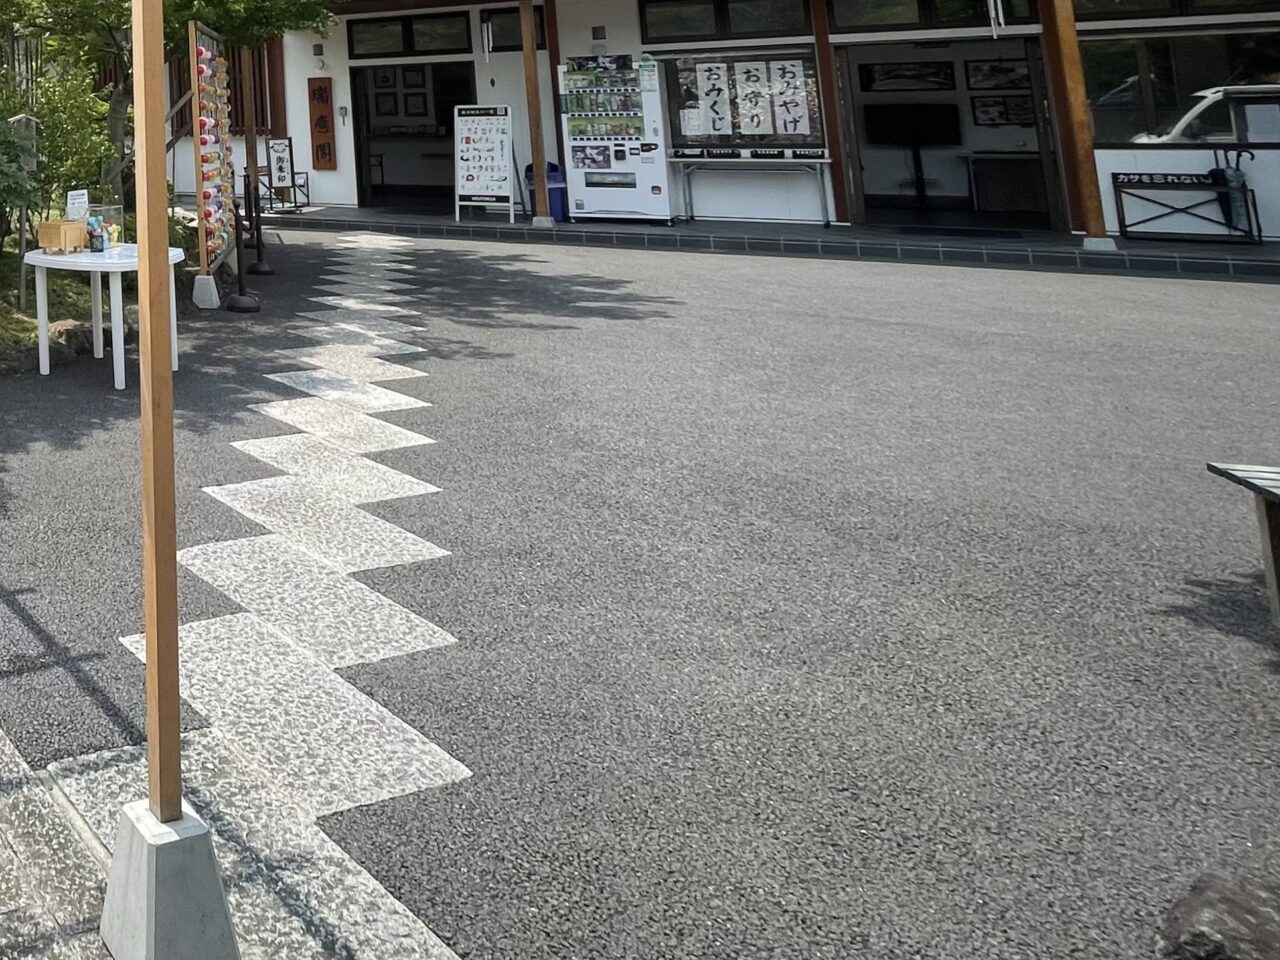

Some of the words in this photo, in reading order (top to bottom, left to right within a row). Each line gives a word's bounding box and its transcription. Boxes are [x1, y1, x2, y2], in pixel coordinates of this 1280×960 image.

[704, 66, 725, 132] おみくじ
[742, 67, 765, 129] お守り
[776, 63, 803, 133] おみやげ
